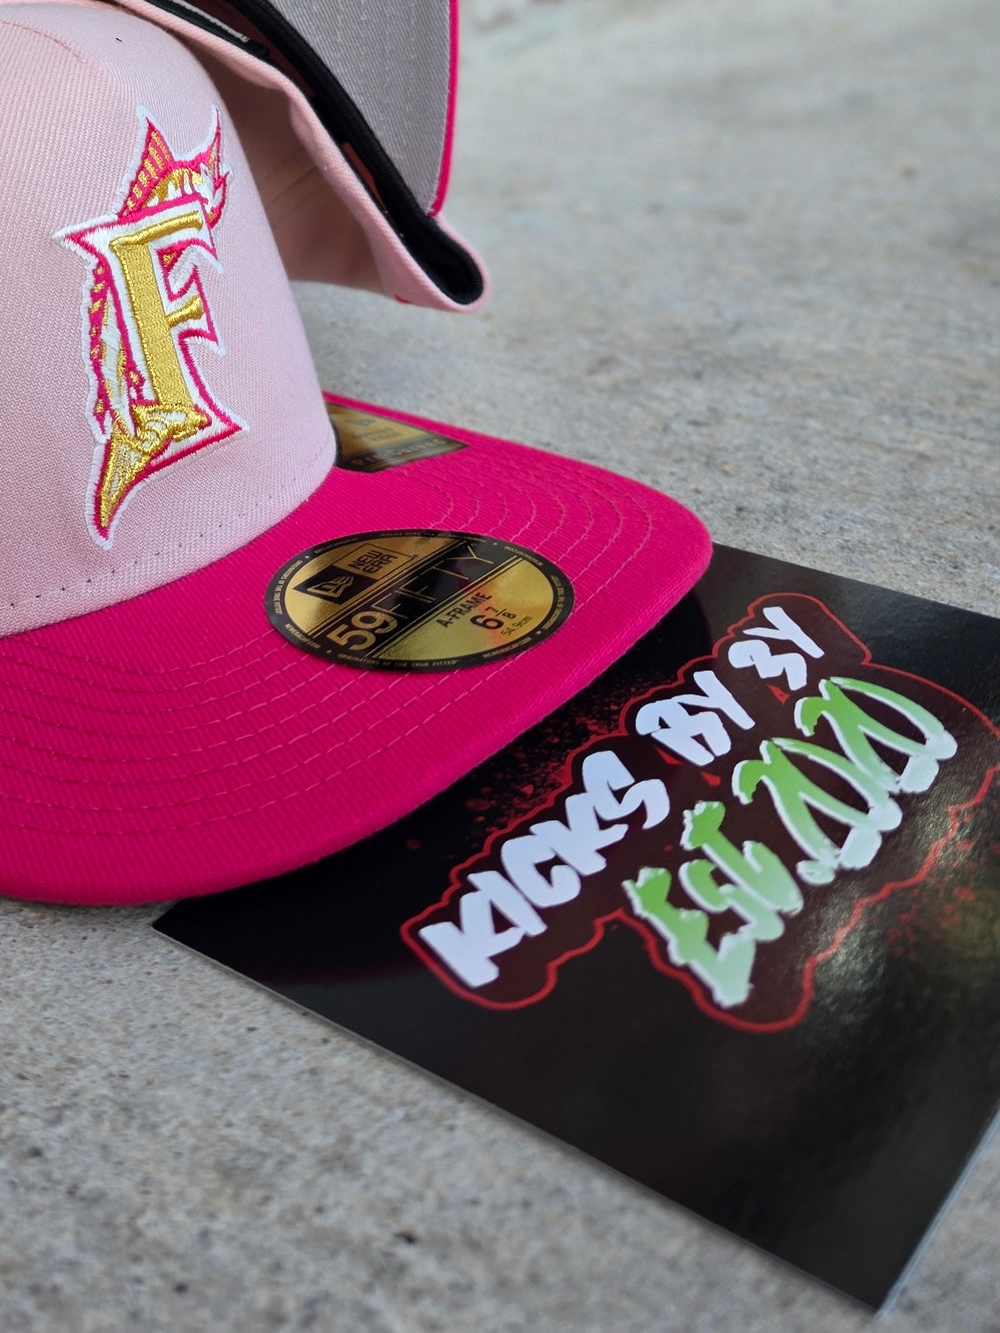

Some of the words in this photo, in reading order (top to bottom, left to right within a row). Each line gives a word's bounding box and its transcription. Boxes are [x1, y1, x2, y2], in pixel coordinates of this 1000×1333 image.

[347, 549, 380, 570] NEW
[362, 552, 400, 575] ERA
[326, 545, 494, 652] 59FIFTY
[436, 592, 493, 628] A-FRAME
[418, 750, 671, 989] KICKS
[635, 669, 756, 767] BY
